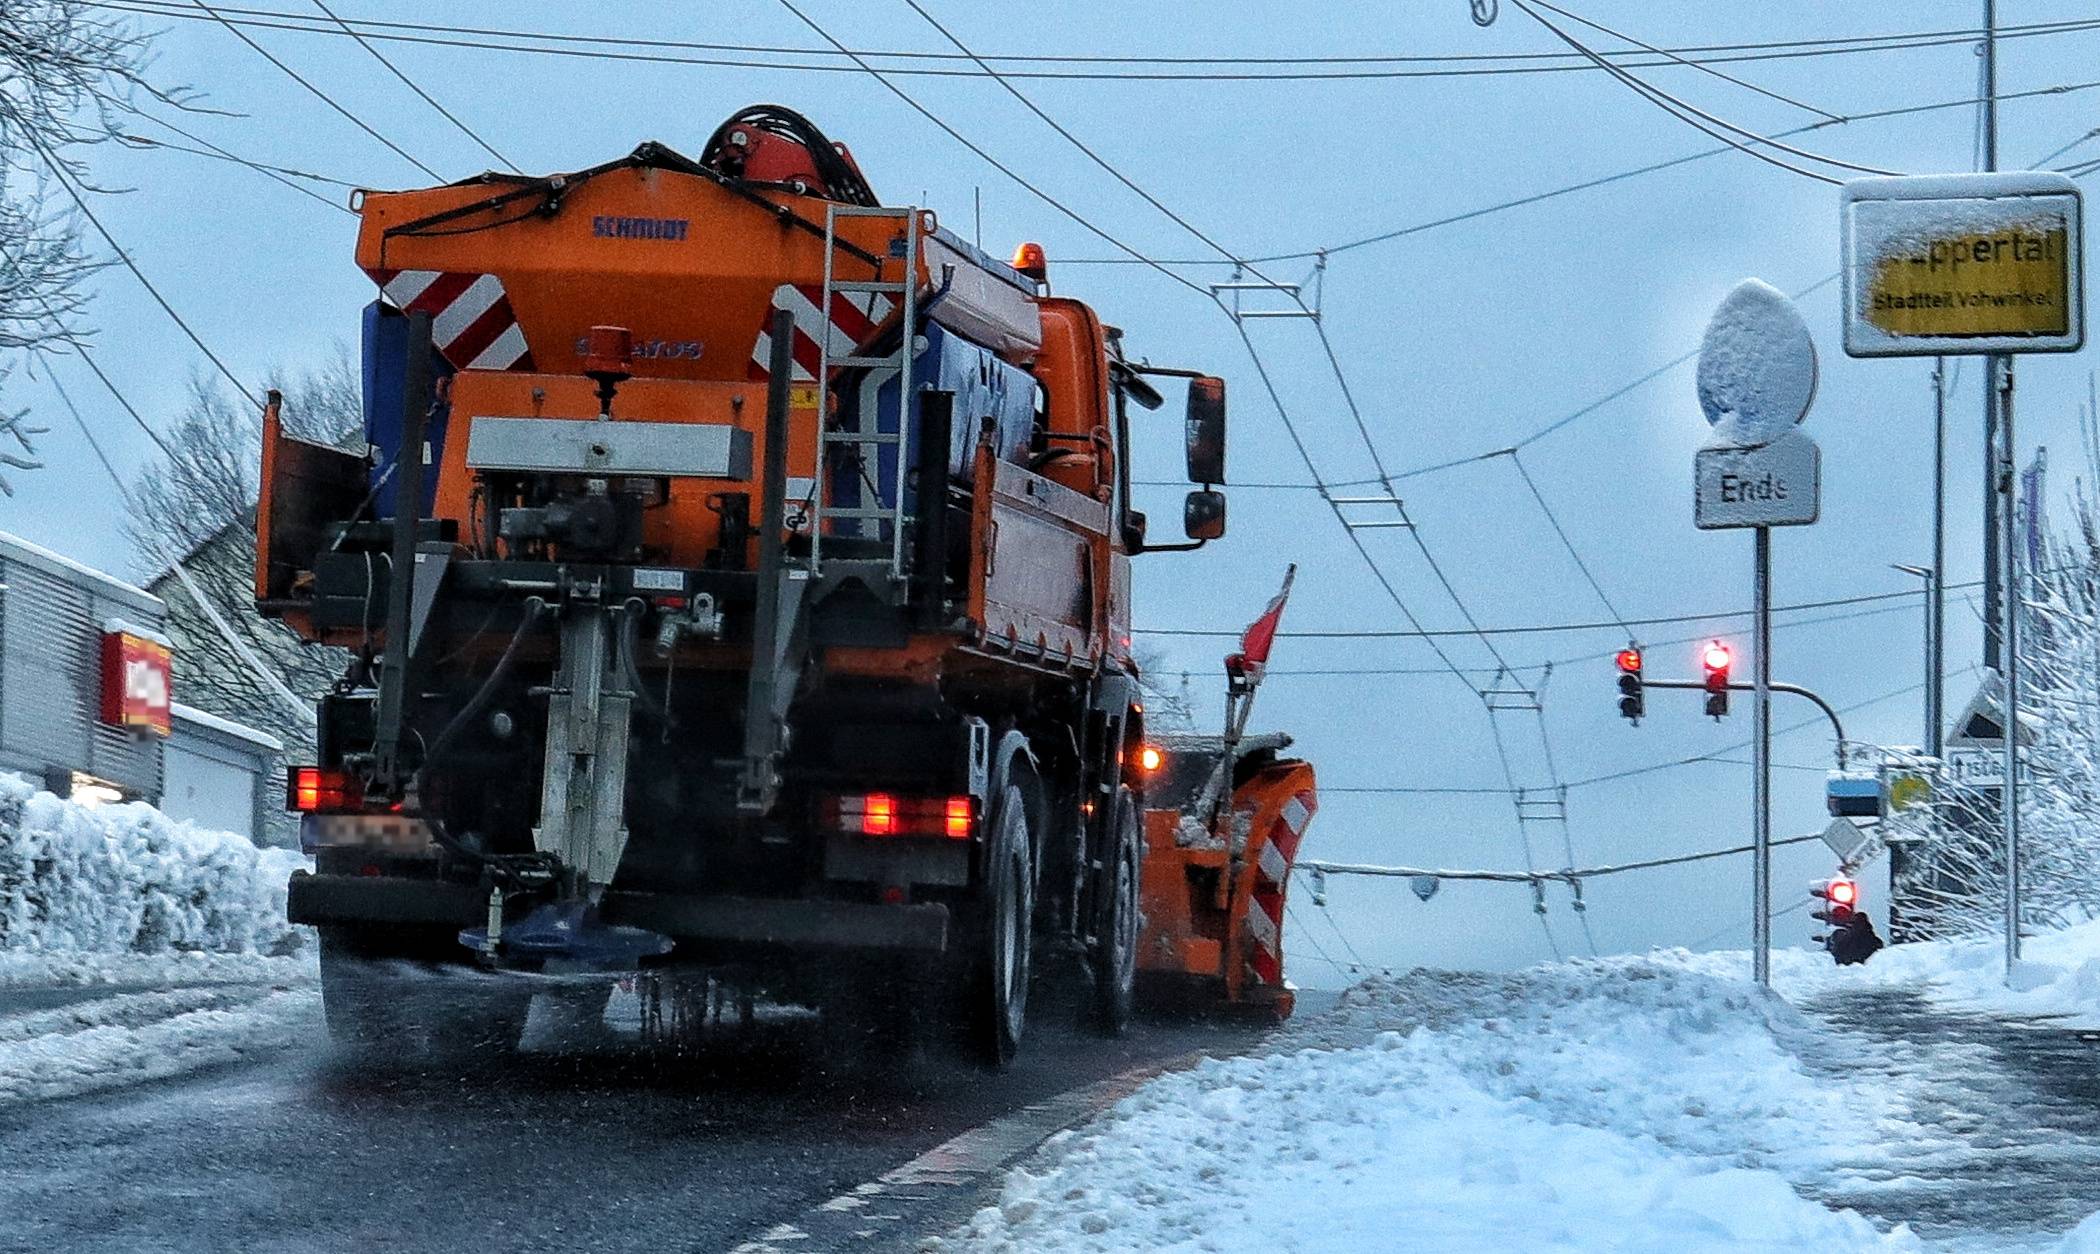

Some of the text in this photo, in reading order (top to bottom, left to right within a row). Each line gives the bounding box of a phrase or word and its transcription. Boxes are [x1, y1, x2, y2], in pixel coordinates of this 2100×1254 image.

[593, 215, 689, 241] SCHMIDT
[1882, 231, 2057, 273] ppertal
[1721, 473, 1788, 503] Ende
